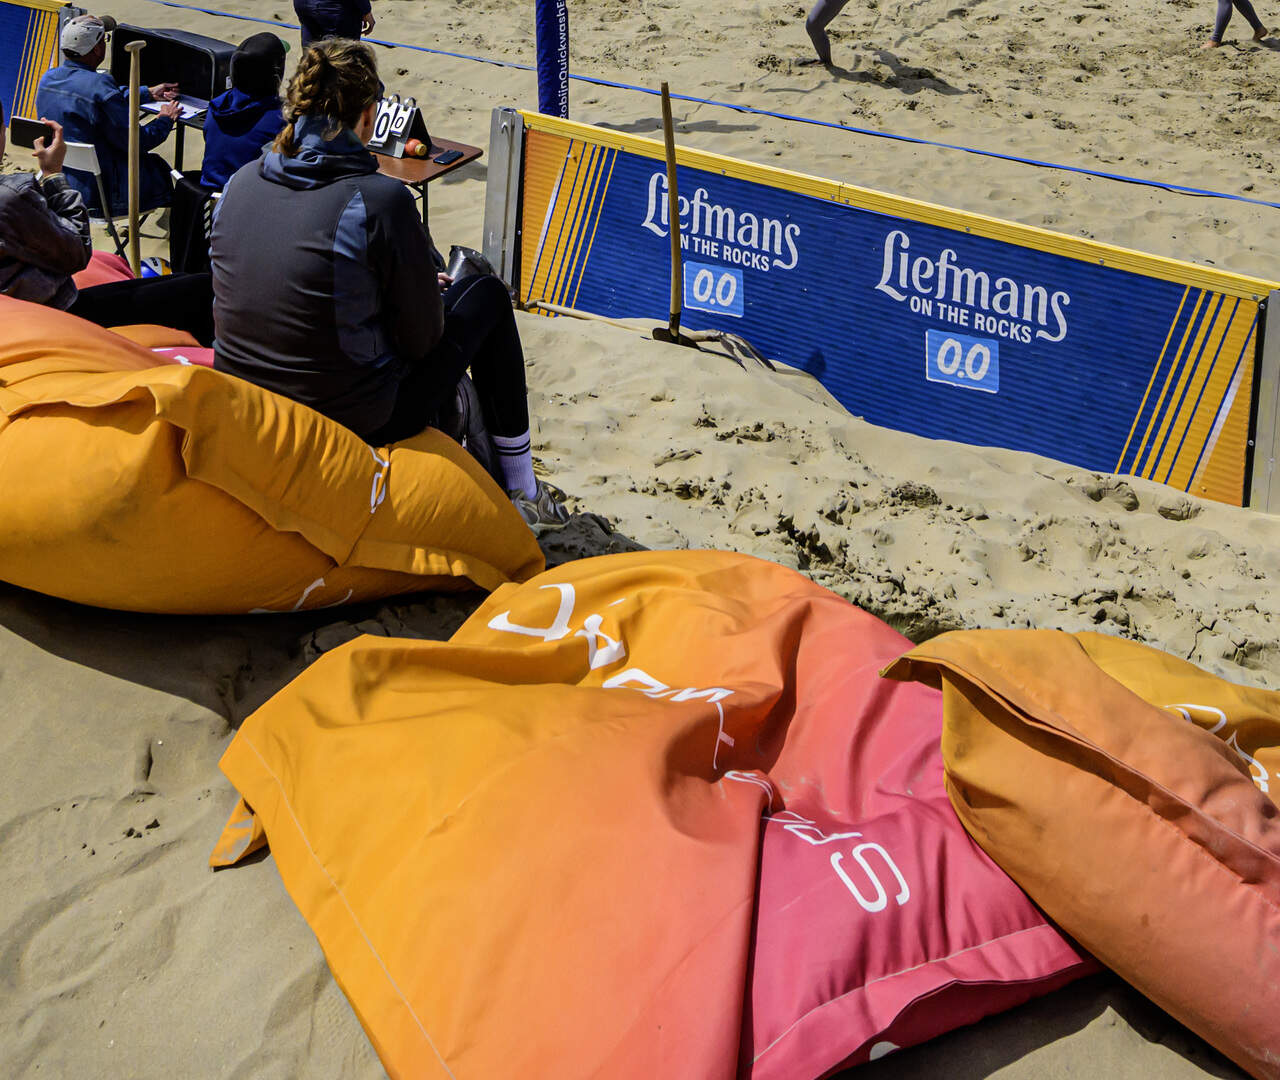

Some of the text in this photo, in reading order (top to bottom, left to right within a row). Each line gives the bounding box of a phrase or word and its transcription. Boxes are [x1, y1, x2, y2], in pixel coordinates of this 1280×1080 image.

[375, 112, 391, 138] 0
[693, 237, 718, 259] THE
[723, 243, 770, 272] ROCKS
[692, 267, 738, 307] 0.0
[874, 230, 1070, 342] Liefmans
[910, 295, 1032, 344] ON THE ROCKS
[937, 338, 991, 381] 0.0
